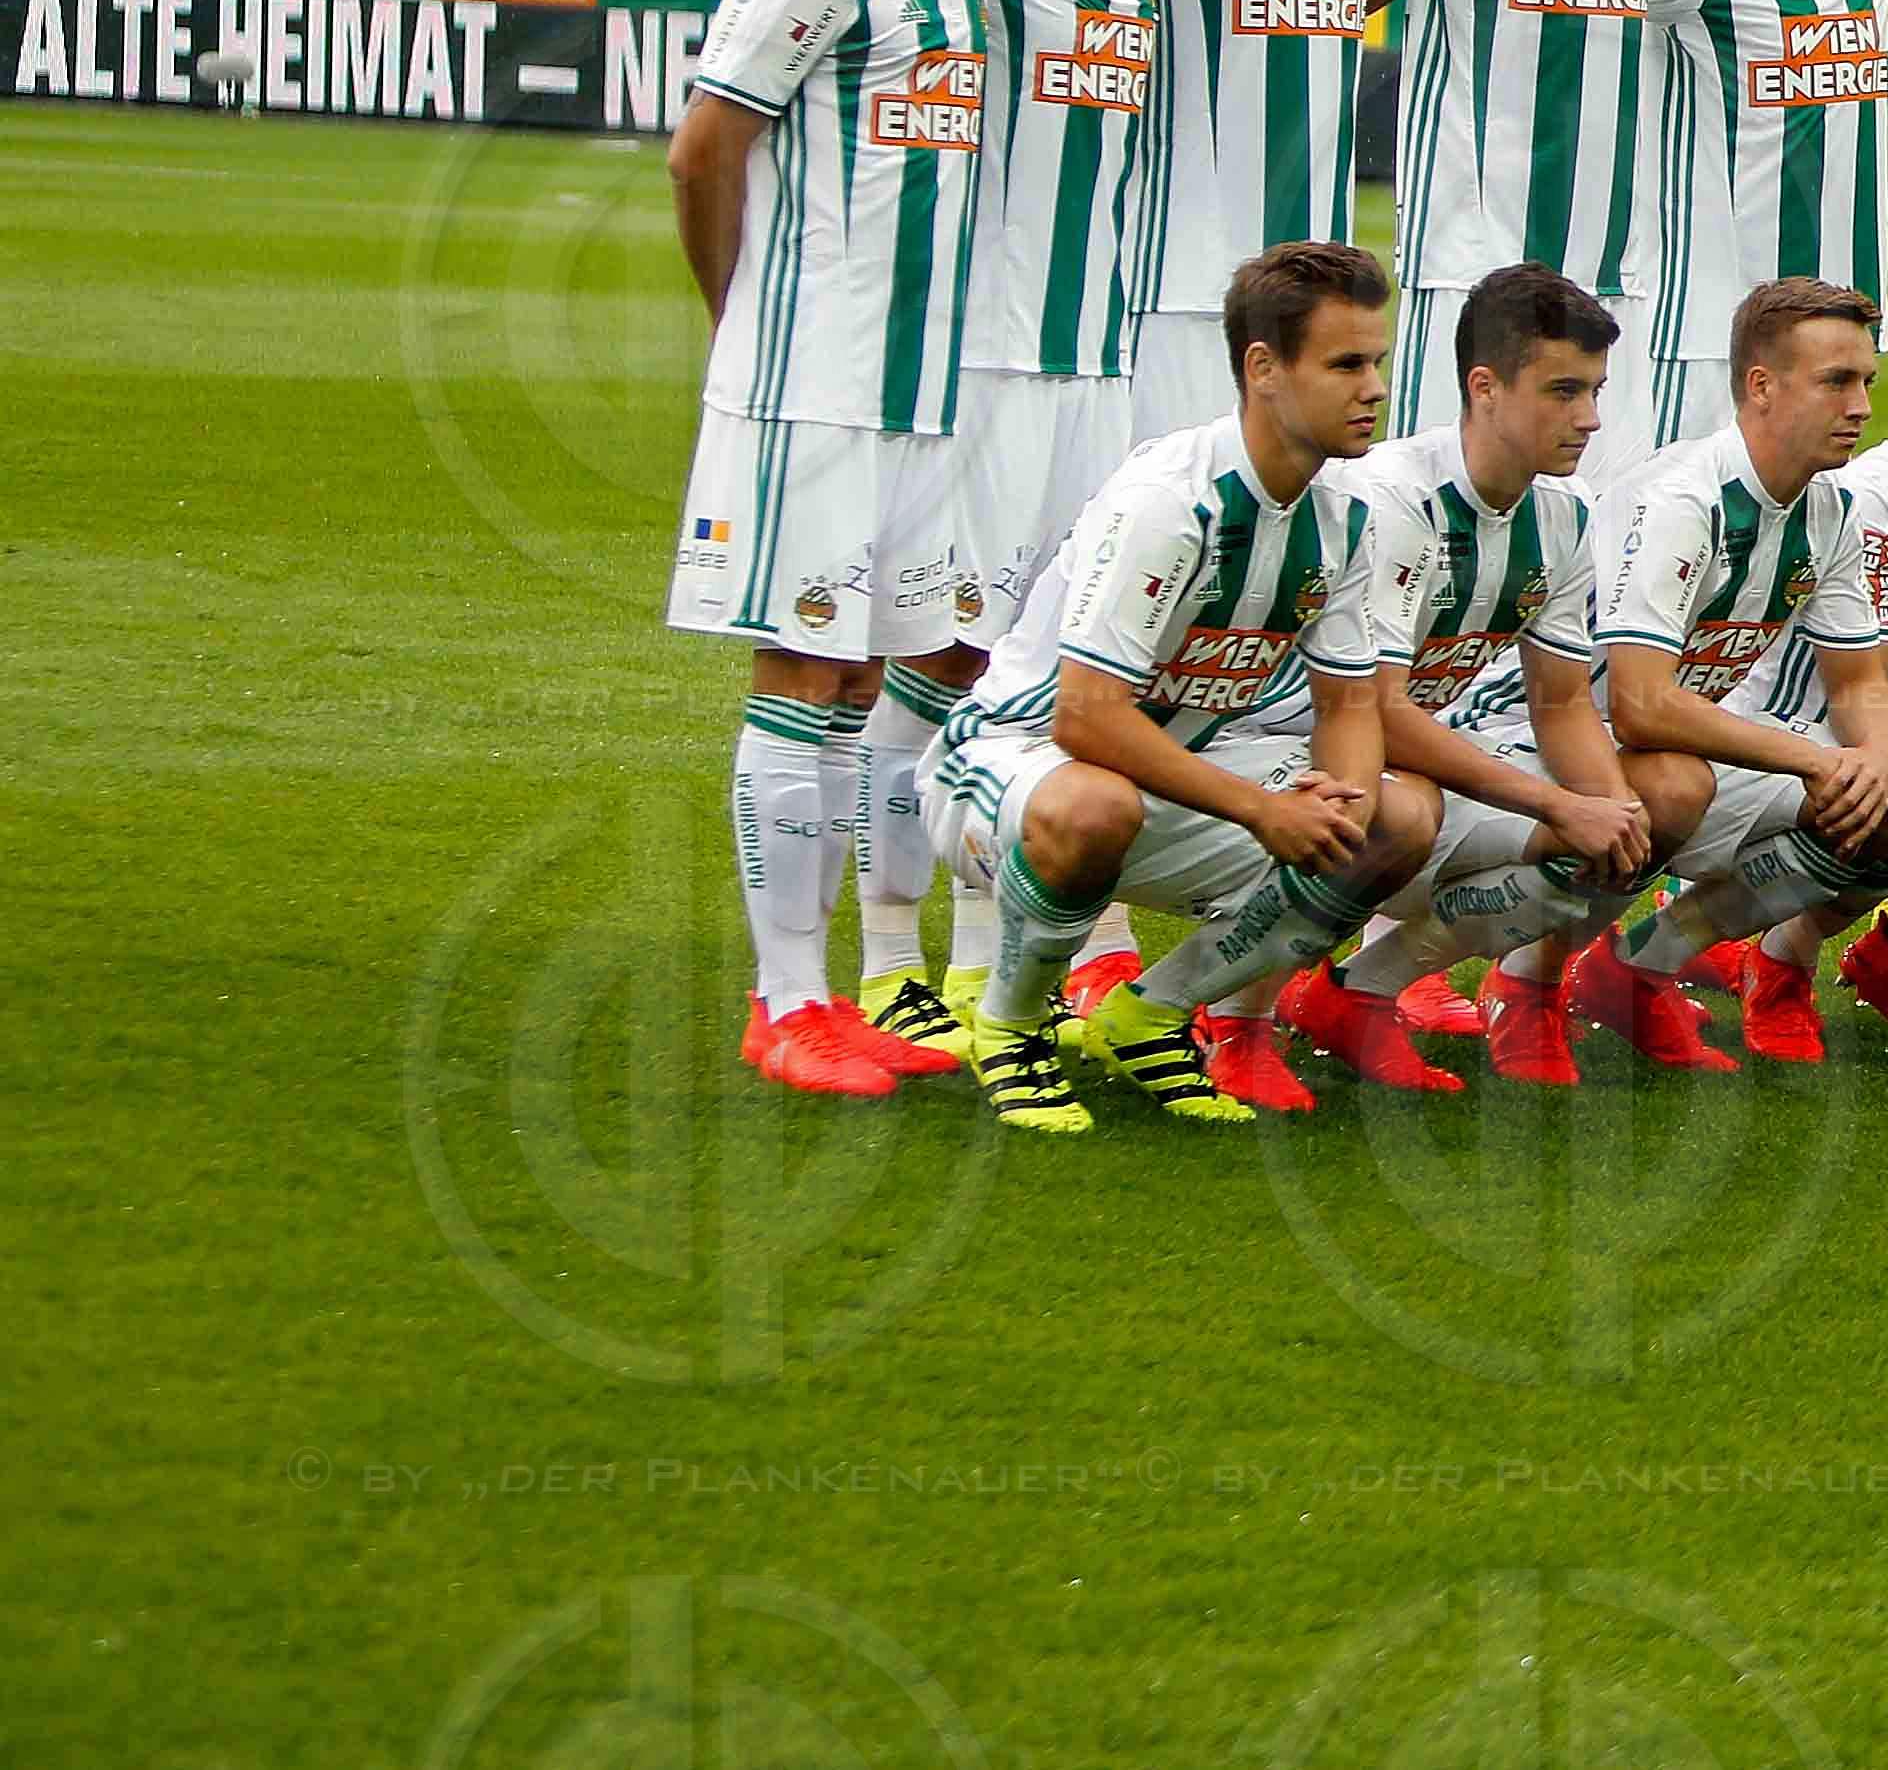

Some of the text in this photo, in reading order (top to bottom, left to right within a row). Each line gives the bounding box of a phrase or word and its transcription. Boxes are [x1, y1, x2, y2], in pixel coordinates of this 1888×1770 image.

[783, 5, 839, 72] WIENWERT
[1789, 18, 1878, 57] WIEN
[1041, 60, 1147, 107] ENERG
[1755, 58, 1888, 103] ENERGIE
[1399, 543, 1434, 619] WIENWERT
[1606, 503, 1648, 618] PS KLIMA
[1676, 542, 1711, 614] WIENWERT
[1066, 569, 1103, 629] KLIMA
[1143, 555, 1188, 631] WIENWERT
[1179, 635, 1291, 671] WIEN
[1413, 638, 1502, 670] WIEN
[1684, 628, 1779, 661] WIEN
